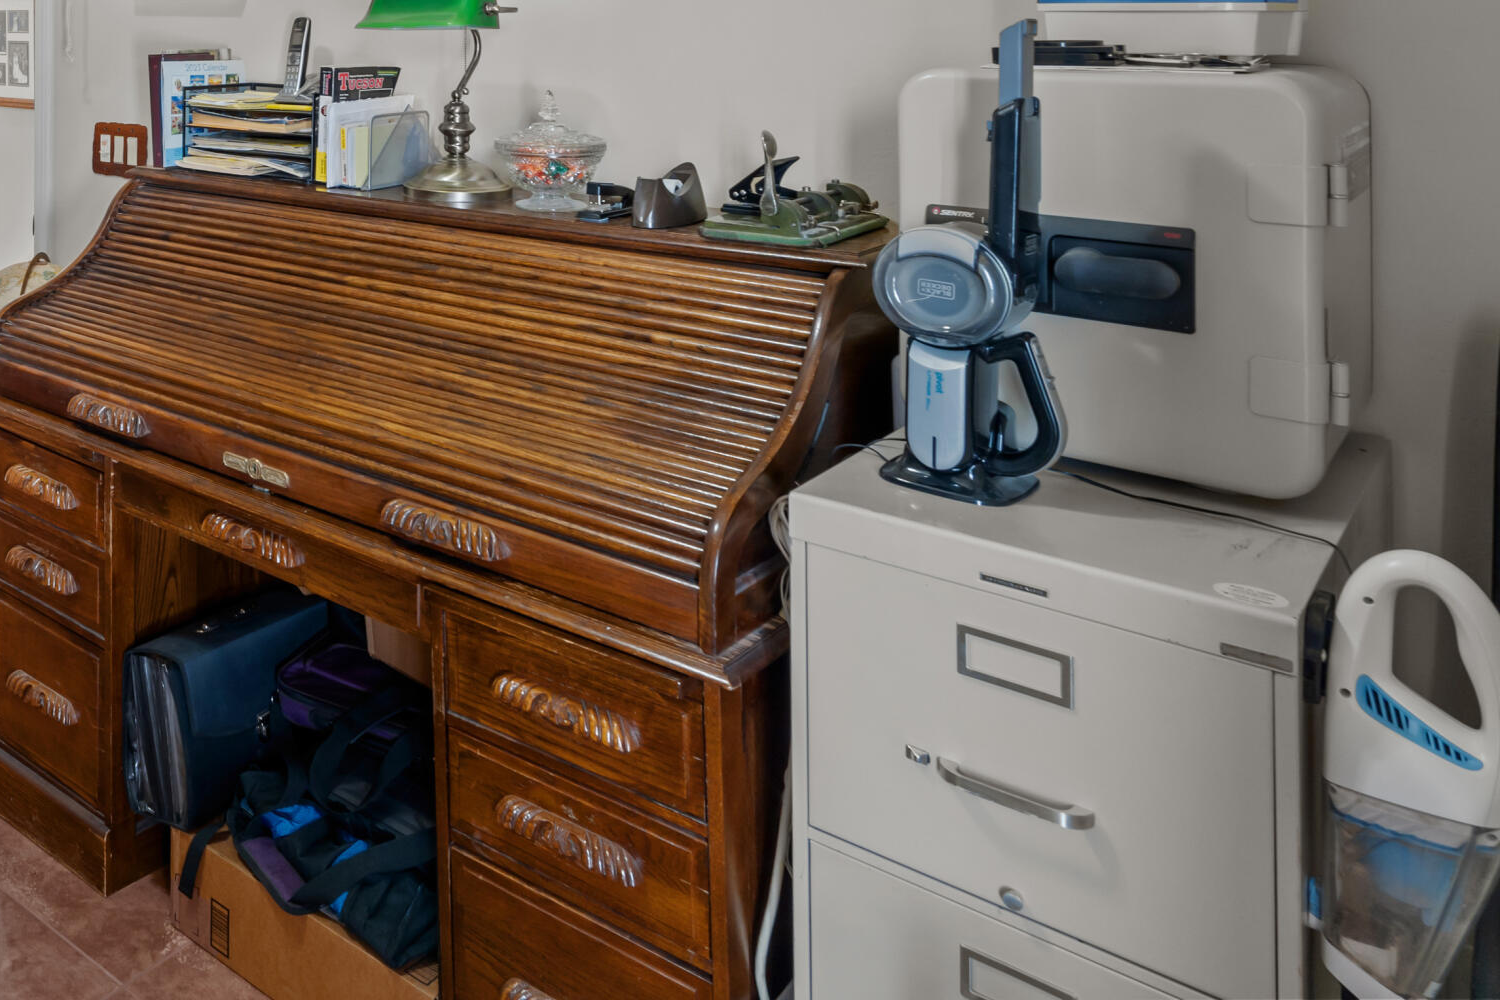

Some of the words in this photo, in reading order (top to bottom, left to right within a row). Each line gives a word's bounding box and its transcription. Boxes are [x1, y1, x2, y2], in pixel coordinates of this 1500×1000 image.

[338, 72, 384, 90] TUCSON
[940, 209, 975, 219] SENTRY
[935, 371, 945, 394] pivot
